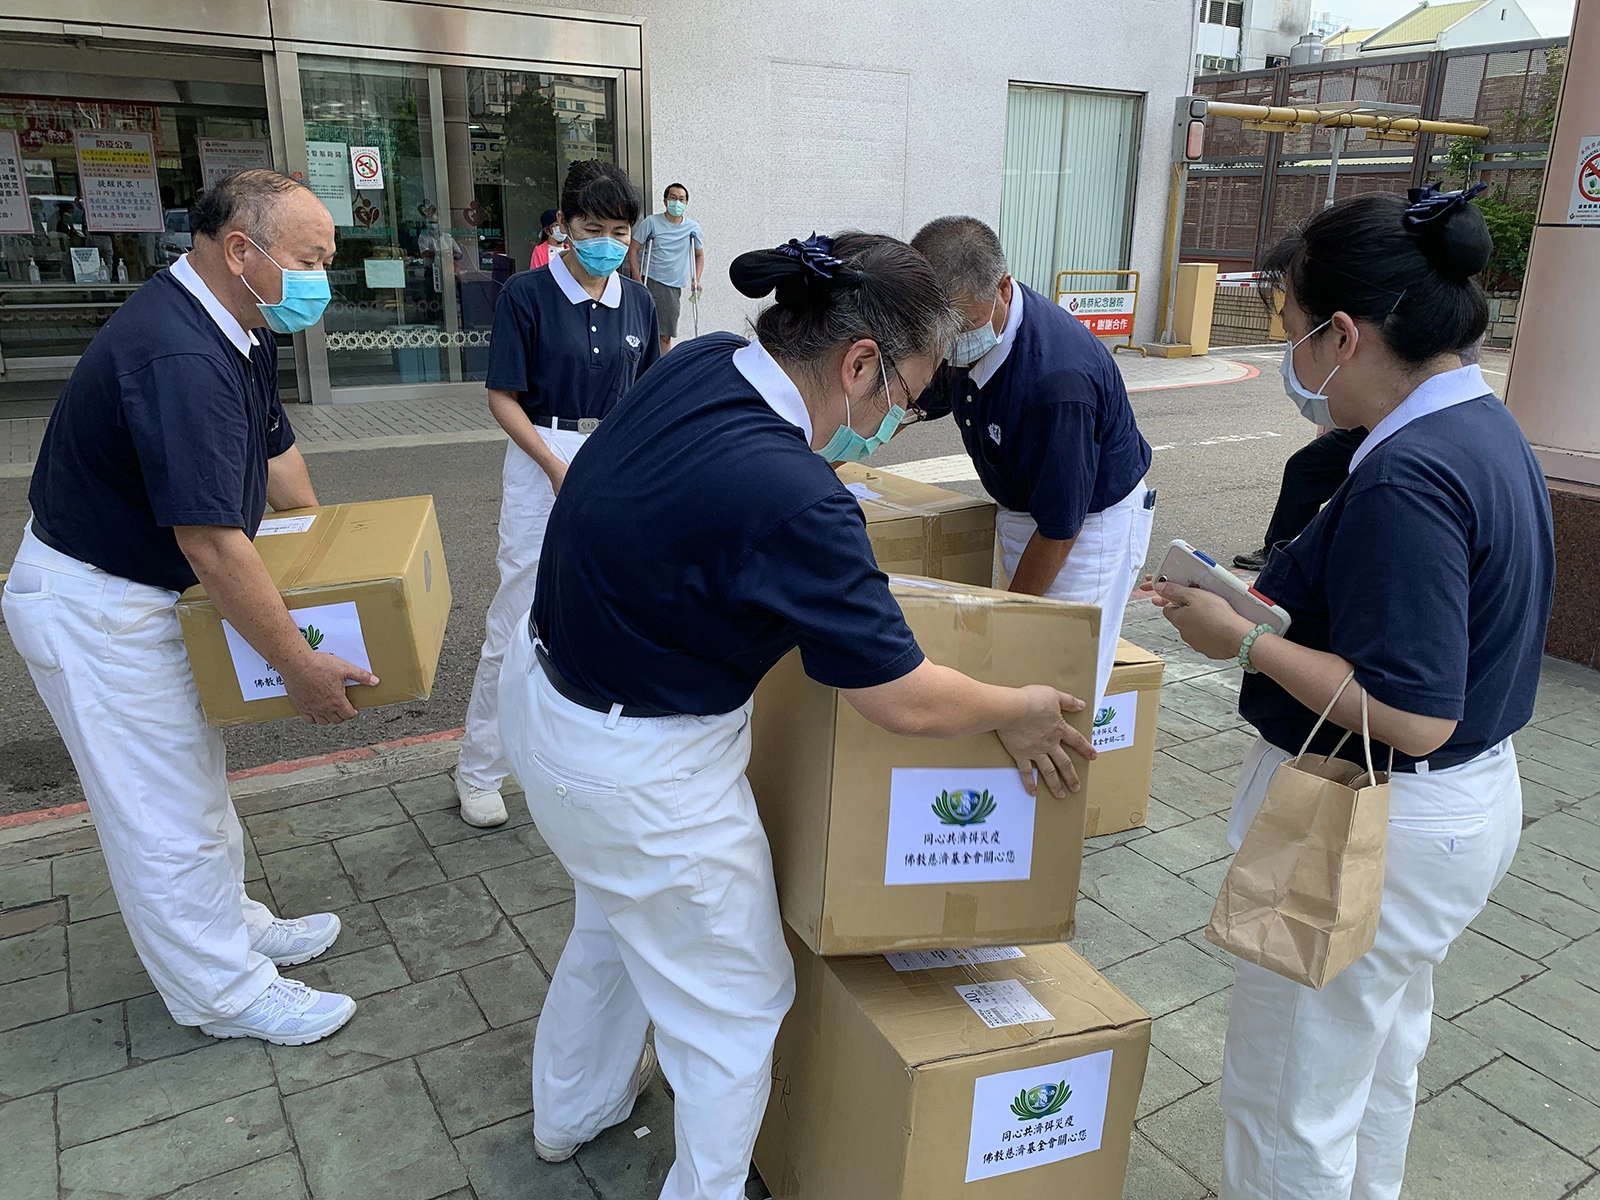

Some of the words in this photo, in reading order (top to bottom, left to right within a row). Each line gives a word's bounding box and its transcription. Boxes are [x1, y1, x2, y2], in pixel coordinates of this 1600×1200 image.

[95, 139, 133, 149] 防疫公告
[306, 150, 342, 158] 管制時間
[923, 830, 1000, 846] 同心共濟弭災疫
[904, 850, 1016, 867] 佛教慈濟基金會關心您
[1001, 1115, 1075, 1142] 同心共濟弭災疫
[982, 1129, 1088, 1165] 佛教慈濟基金會關心您
